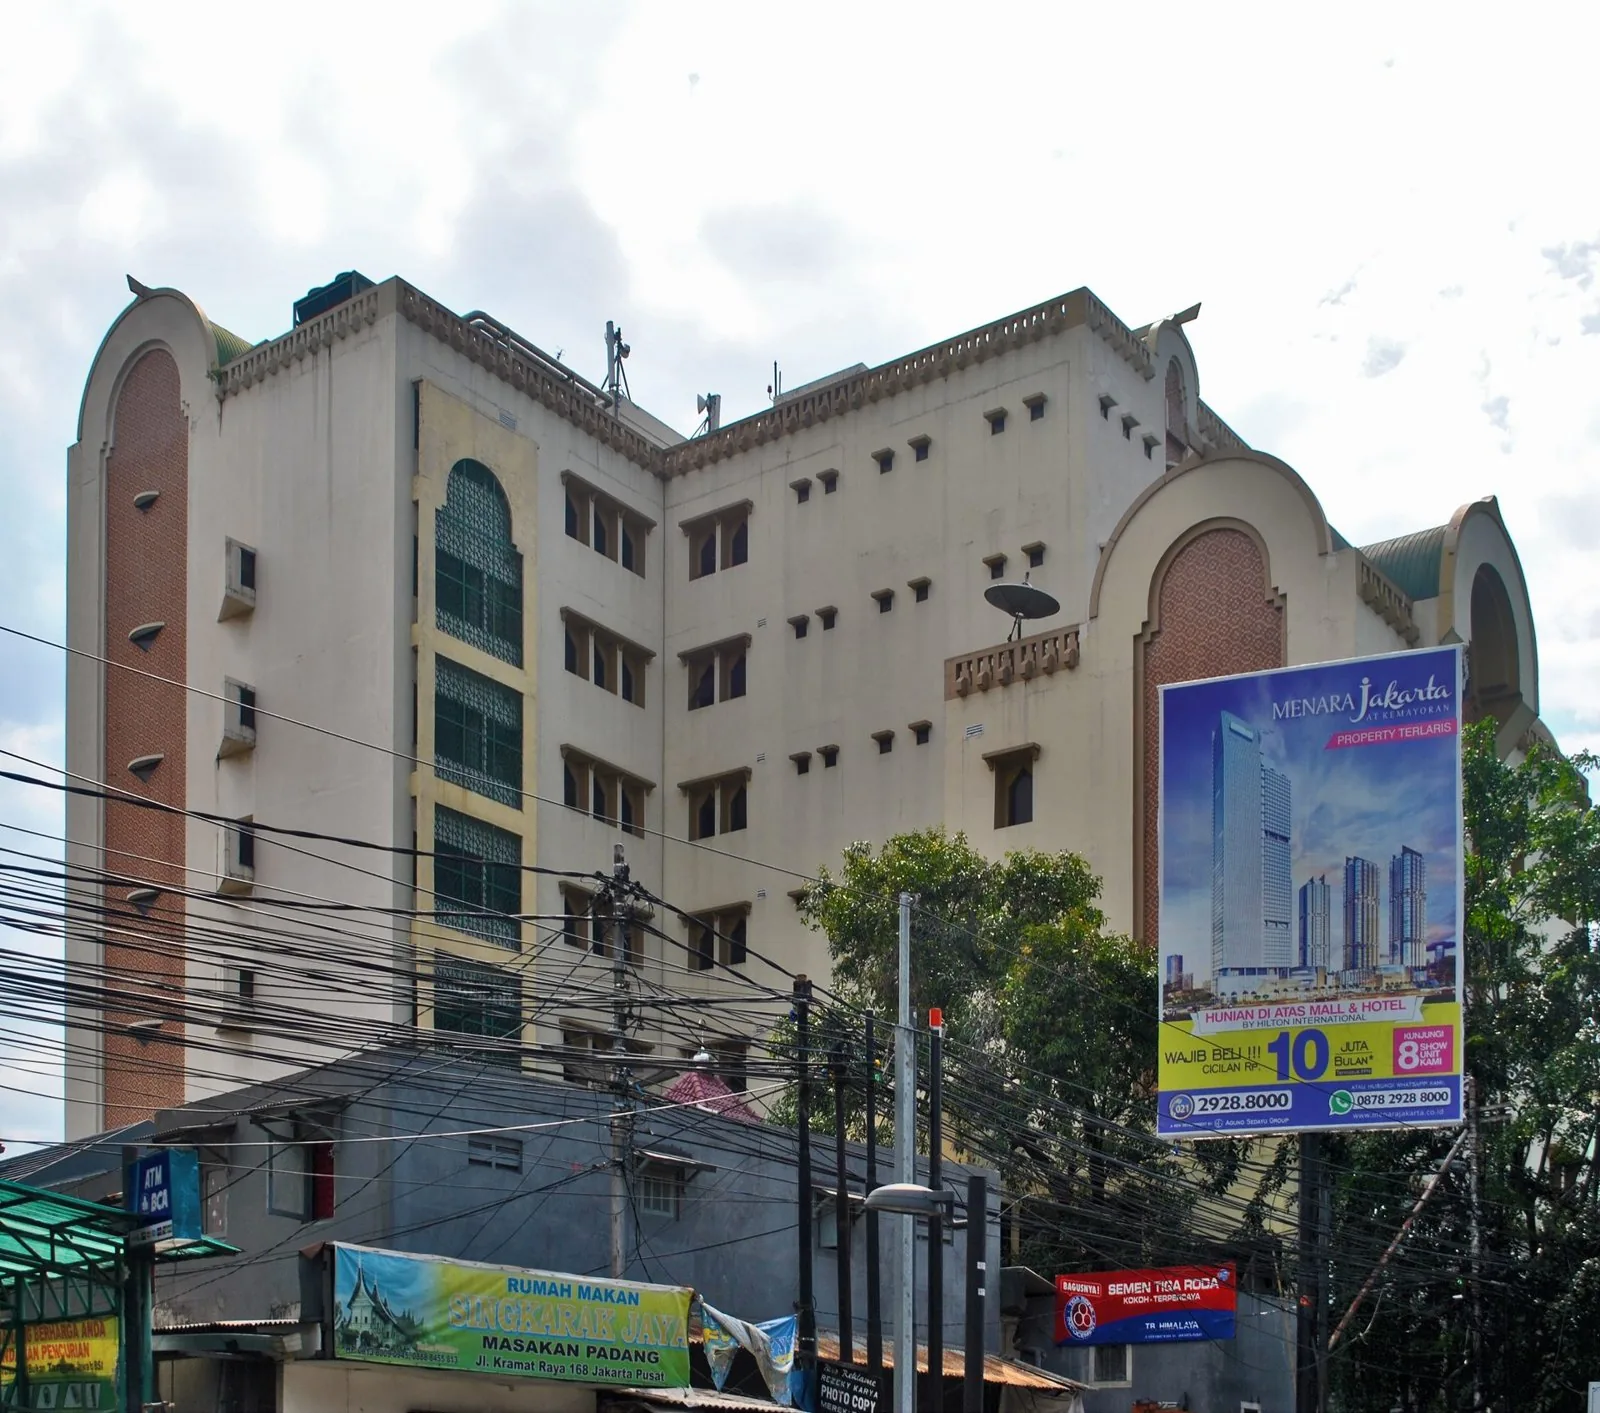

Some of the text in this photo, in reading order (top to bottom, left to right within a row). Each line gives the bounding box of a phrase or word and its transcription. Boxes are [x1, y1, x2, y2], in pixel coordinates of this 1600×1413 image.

[1272, 693, 1355, 720] MENARA
[1382, 705, 1450, 720] KEMAYORAN
[1337, 722, 1452, 745] PROPERTY TERLARIS
[1205, 1000, 1407, 1023] HUNIAN DI ATAS MALL & HOTEL
[1257, 1018, 1289, 1027] HILTON
[1292, 1014, 1367, 1025] INTERNATIONAL
[1403, 1030, 1444, 1039] KUNJUNGI
[1267, 1028, 1330, 1081] 10
[1340, 1040, 1369, 1052] JUTA
[1397, 1040, 1420, 1069] 8
[1420, 1042, 1448, 1051] SHOW
[1420, 1050, 1440, 1058] UNIT
[1164, 1050, 1207, 1064] WAJIB
[1212, 1047, 1242, 1061] BELI
[1420, 1058, 1442, 1066] KAMI
[1202, 1062, 1241, 1074] CICILAN
[1175, 1093, 1289, 1113] 021 2928.8000
[1357, 1091, 1449, 1106] 0878 2928 8000
[145, 1165, 162, 1189] ATM
[150, 1189, 168, 1212] BCA
[507, 1277, 640, 1306] RUMAH MAKAN
[1063, 1281, 1100, 1295] BAGUSNYA!
[1108, 1277, 1219, 1295] SEMEN TIGA RODA
[35, 1321, 79, 1341] BERHARGA
[82, 1320, 106, 1337] ANDA
[450, 1295, 689, 1349] SINGKARAK JAYA
[1159, 1321, 1199, 1330] HIMALAYA
[41, 1342, 90, 1360] PENCURIAN
[482, 1335, 660, 1364] MASAKAN PADANG
[475, 1356, 666, 1382] Jl. Kramat Raya 168 Jakarta Pusat
[821, 1384, 876, 1413] PHOTO COPY
[853, 1384, 878, 1399] KARYA
